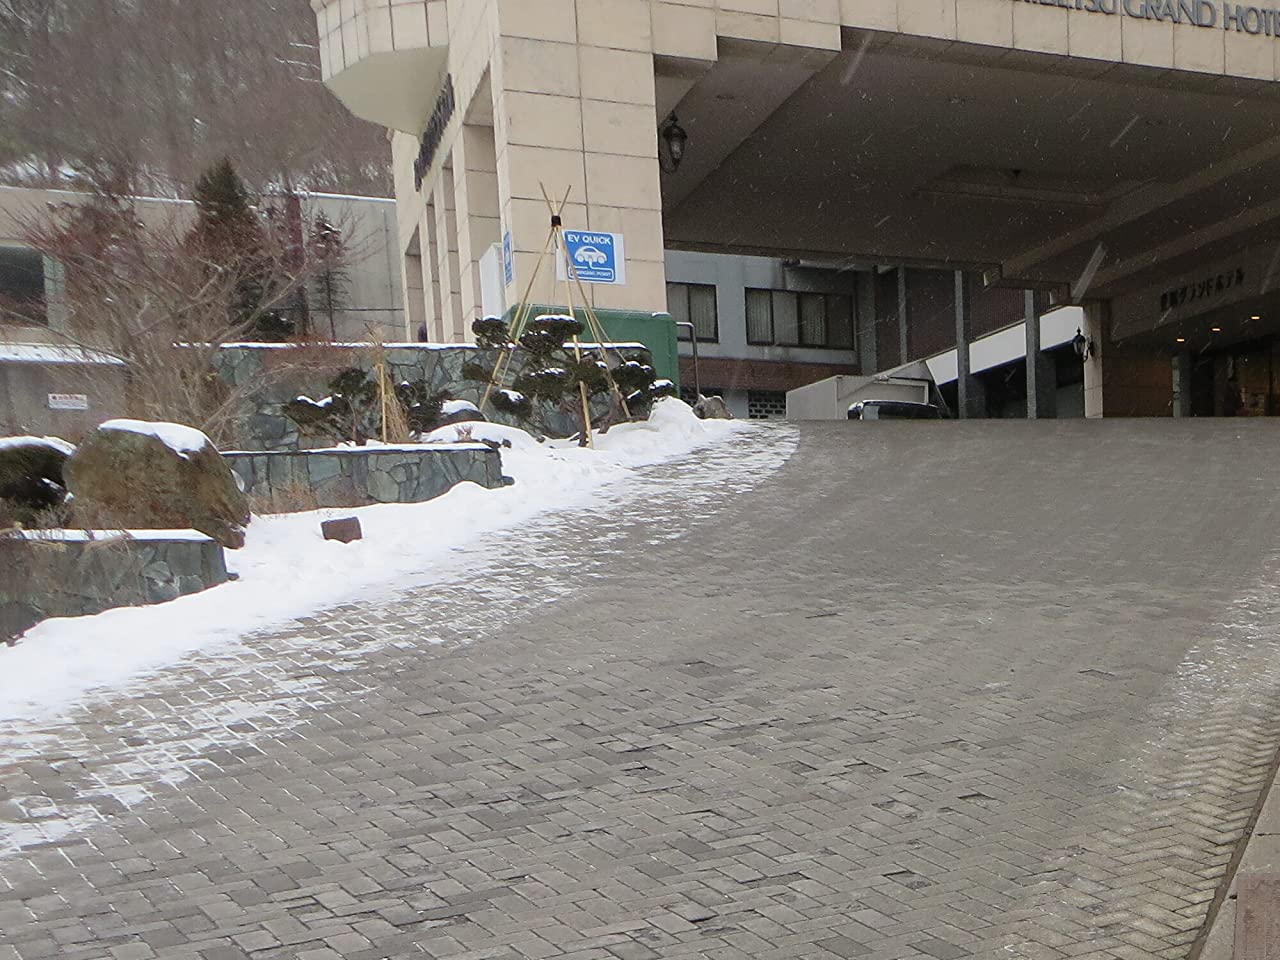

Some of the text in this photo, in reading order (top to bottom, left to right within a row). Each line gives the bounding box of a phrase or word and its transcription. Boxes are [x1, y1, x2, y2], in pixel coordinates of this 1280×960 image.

[1123, 0, 1217, 28] GRAND
[568, 234, 612, 245] EV QUICK
